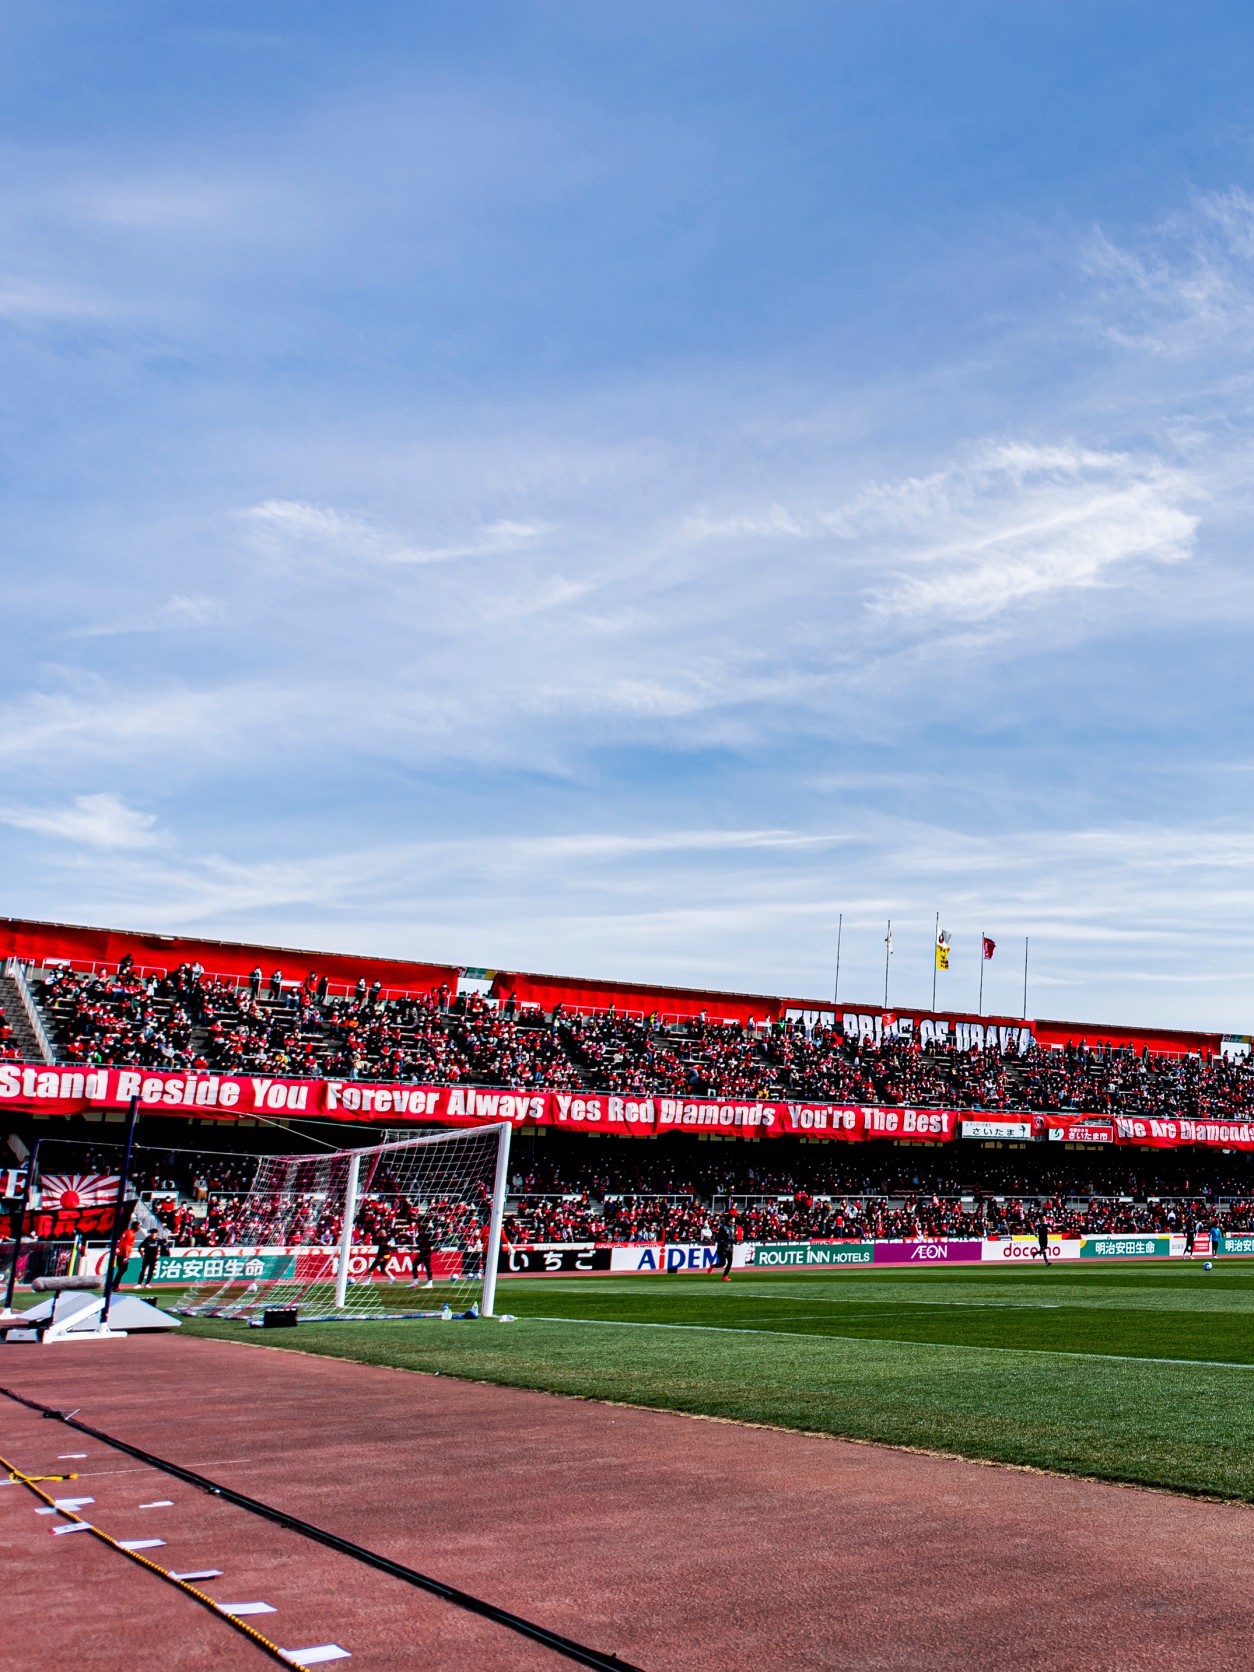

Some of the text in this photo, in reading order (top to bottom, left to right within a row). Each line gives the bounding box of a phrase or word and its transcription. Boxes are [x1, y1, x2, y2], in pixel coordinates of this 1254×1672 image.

[0, 1065, 309, 1110] Stand Beside You
[327, 1082, 545, 1121] Forever Always
[556, 1095, 949, 1133] Yes Red Diamonds You're The Best
[972, 1127, 1015, 1136] さいたま
[1068, 1132, 1108, 1140] さいたま市
[1115, 1118, 1146, 1138] We
[1150, 1119, 1176, 1139] Are
[759, 1251, 803, 1265] ROUTE
[833, 1252, 869, 1263] HOTELS
[1095, 1241, 1155, 1255] 明治安田生命
[509, 1250, 596, 1271] いちご
[637, 1248, 719, 1270] AiDEM
